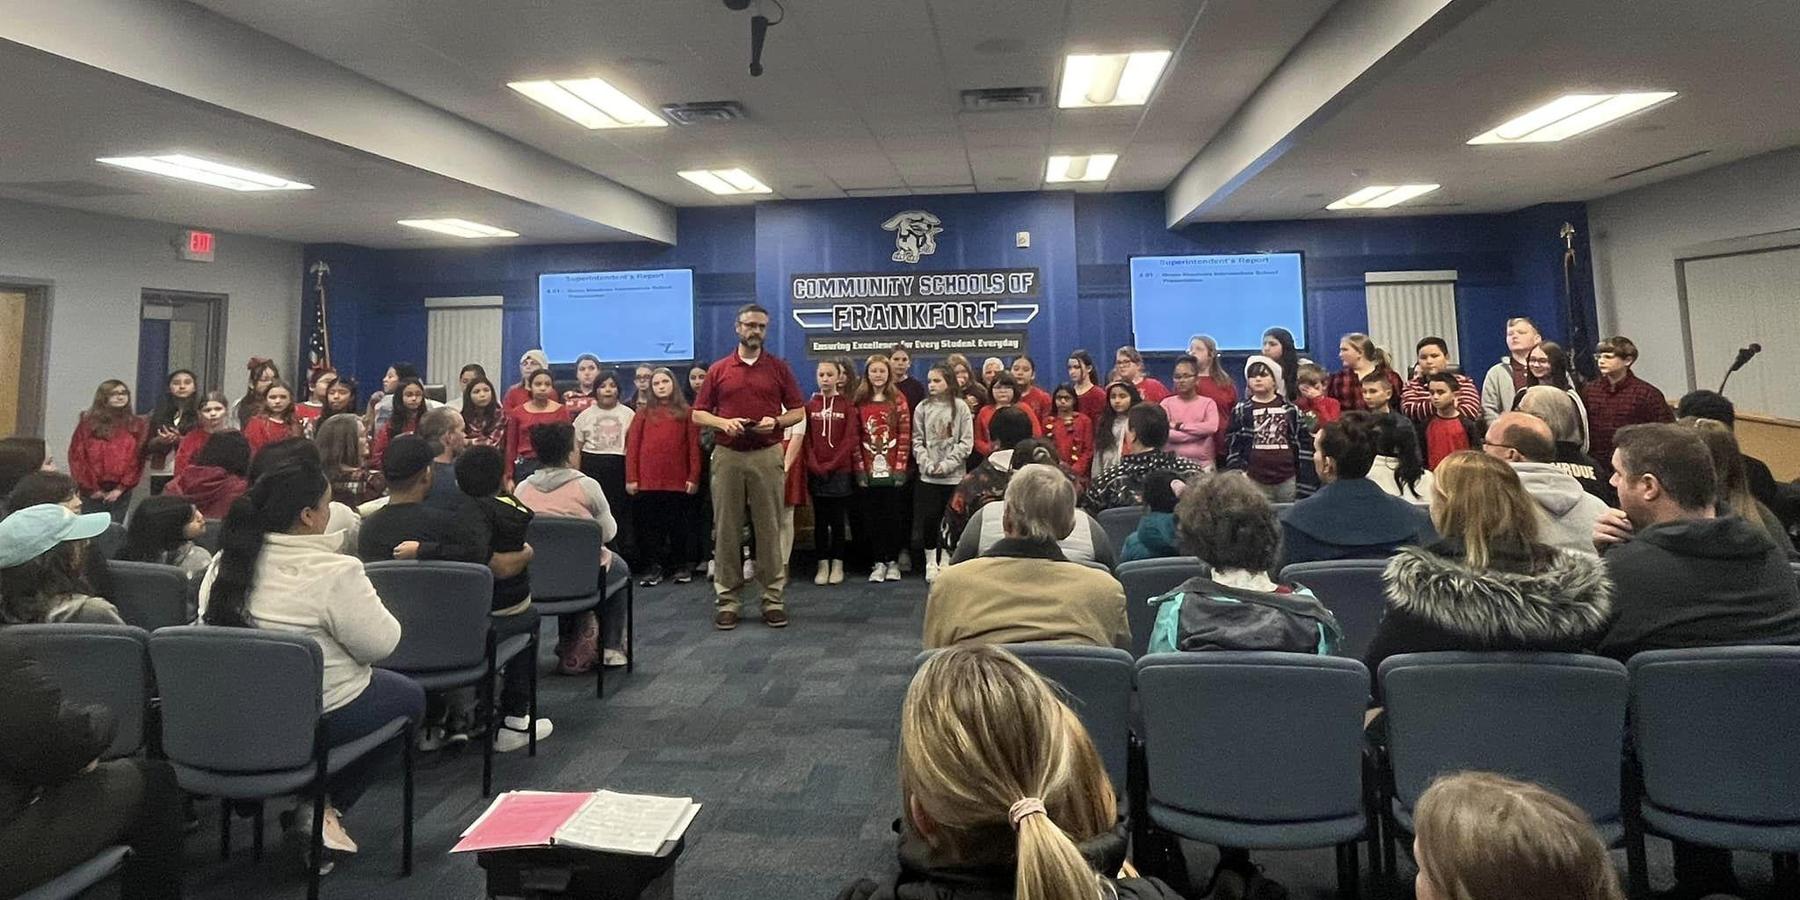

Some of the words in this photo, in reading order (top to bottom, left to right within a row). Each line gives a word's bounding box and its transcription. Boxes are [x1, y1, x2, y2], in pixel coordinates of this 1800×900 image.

[793, 276, 913, 299] COMMUNITY
[919, 274, 1004, 296] SCHOOLS
[1009, 272, 1034, 294] OF
[832, 301, 998, 331] FRANKFORT
[813, 342, 851, 351] Ensuring
[914, 340, 940, 350] Every
[940, 339, 976, 348] Student
[977, 338, 1019, 349] Everyday
